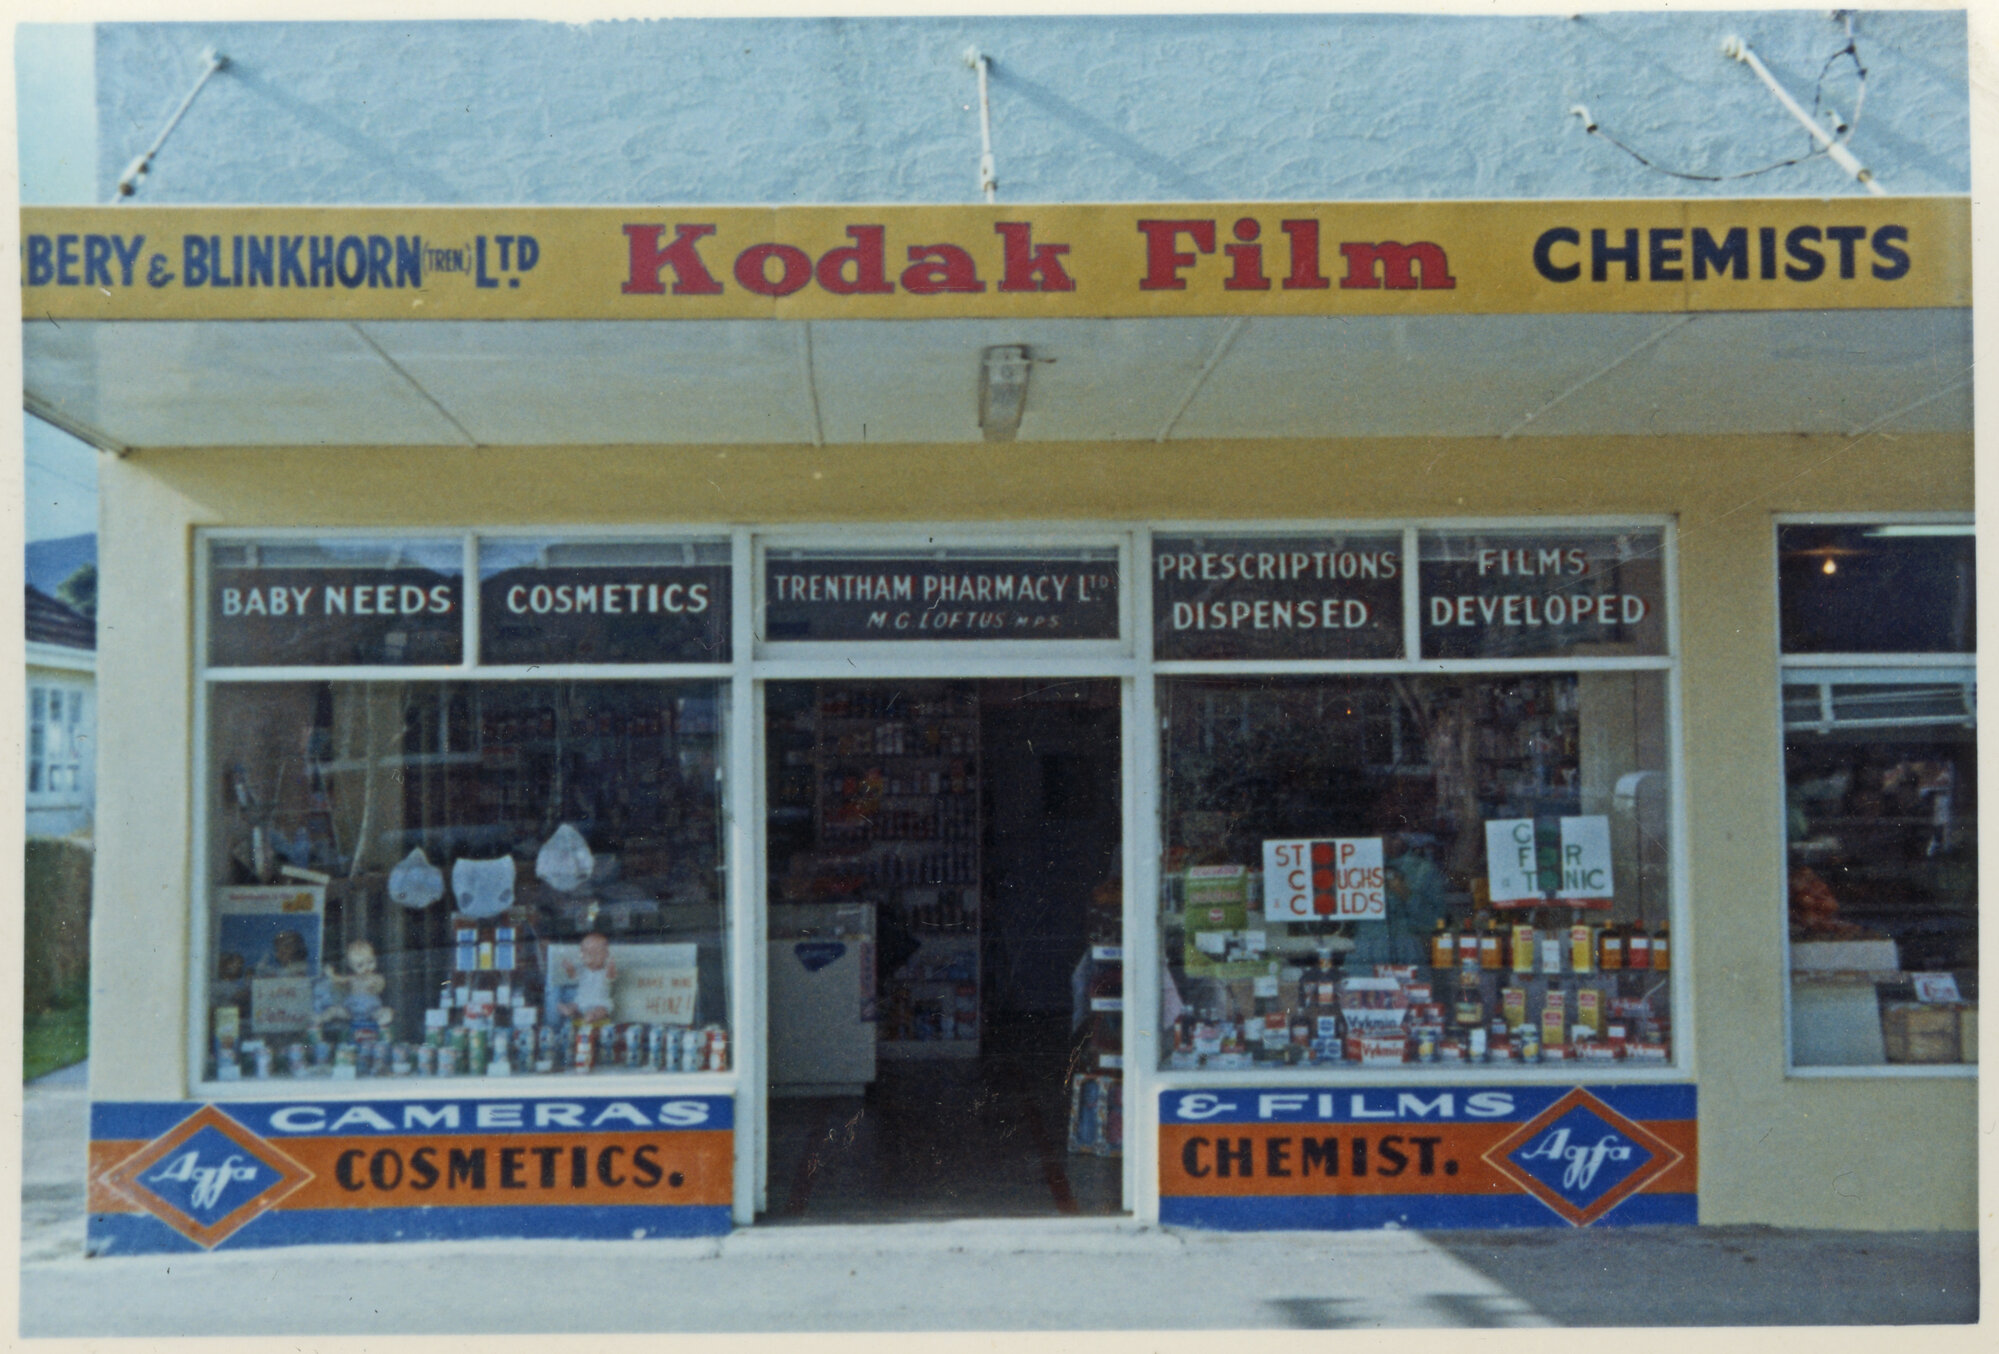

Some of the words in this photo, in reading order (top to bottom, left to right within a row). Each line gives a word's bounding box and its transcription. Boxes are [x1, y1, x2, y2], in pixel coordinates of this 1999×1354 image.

[20, 233, 146, 287] BERY
[147, 253, 176, 288] &
[182, 234, 422, 288] BLINKHORN
[621, 219, 1076, 297] Kodak
[1138, 214, 1457, 294] Film
[1533, 225, 1910, 283] CHEMISTS
[1158, 551, 1399, 581] PRESCRIPTIONS
[1478, 547, 1590, 577] FILMS
[222, 586, 313, 618] BABY
[324, 584, 455, 616] NEEDS
[506, 583, 710, 615] COSMETICS
[774, 574, 914, 603] TRENTHAM
[922, 574, 1069, 603] PHARMACY
[1431, 594, 1650, 627] DEVELOPED
[269, 1099, 711, 1133] CAMERAS
[1176, 1093, 1237, 1120] &
[1258, 1092, 1516, 1119] FILMS
[334, 1143, 685, 1191] COSMETICS.
[1181, 1135, 1460, 1179] CHEMIST.
[1520, 1127, 1632, 1191] Agfa
[150, 1146, 258, 1209] Agfa
